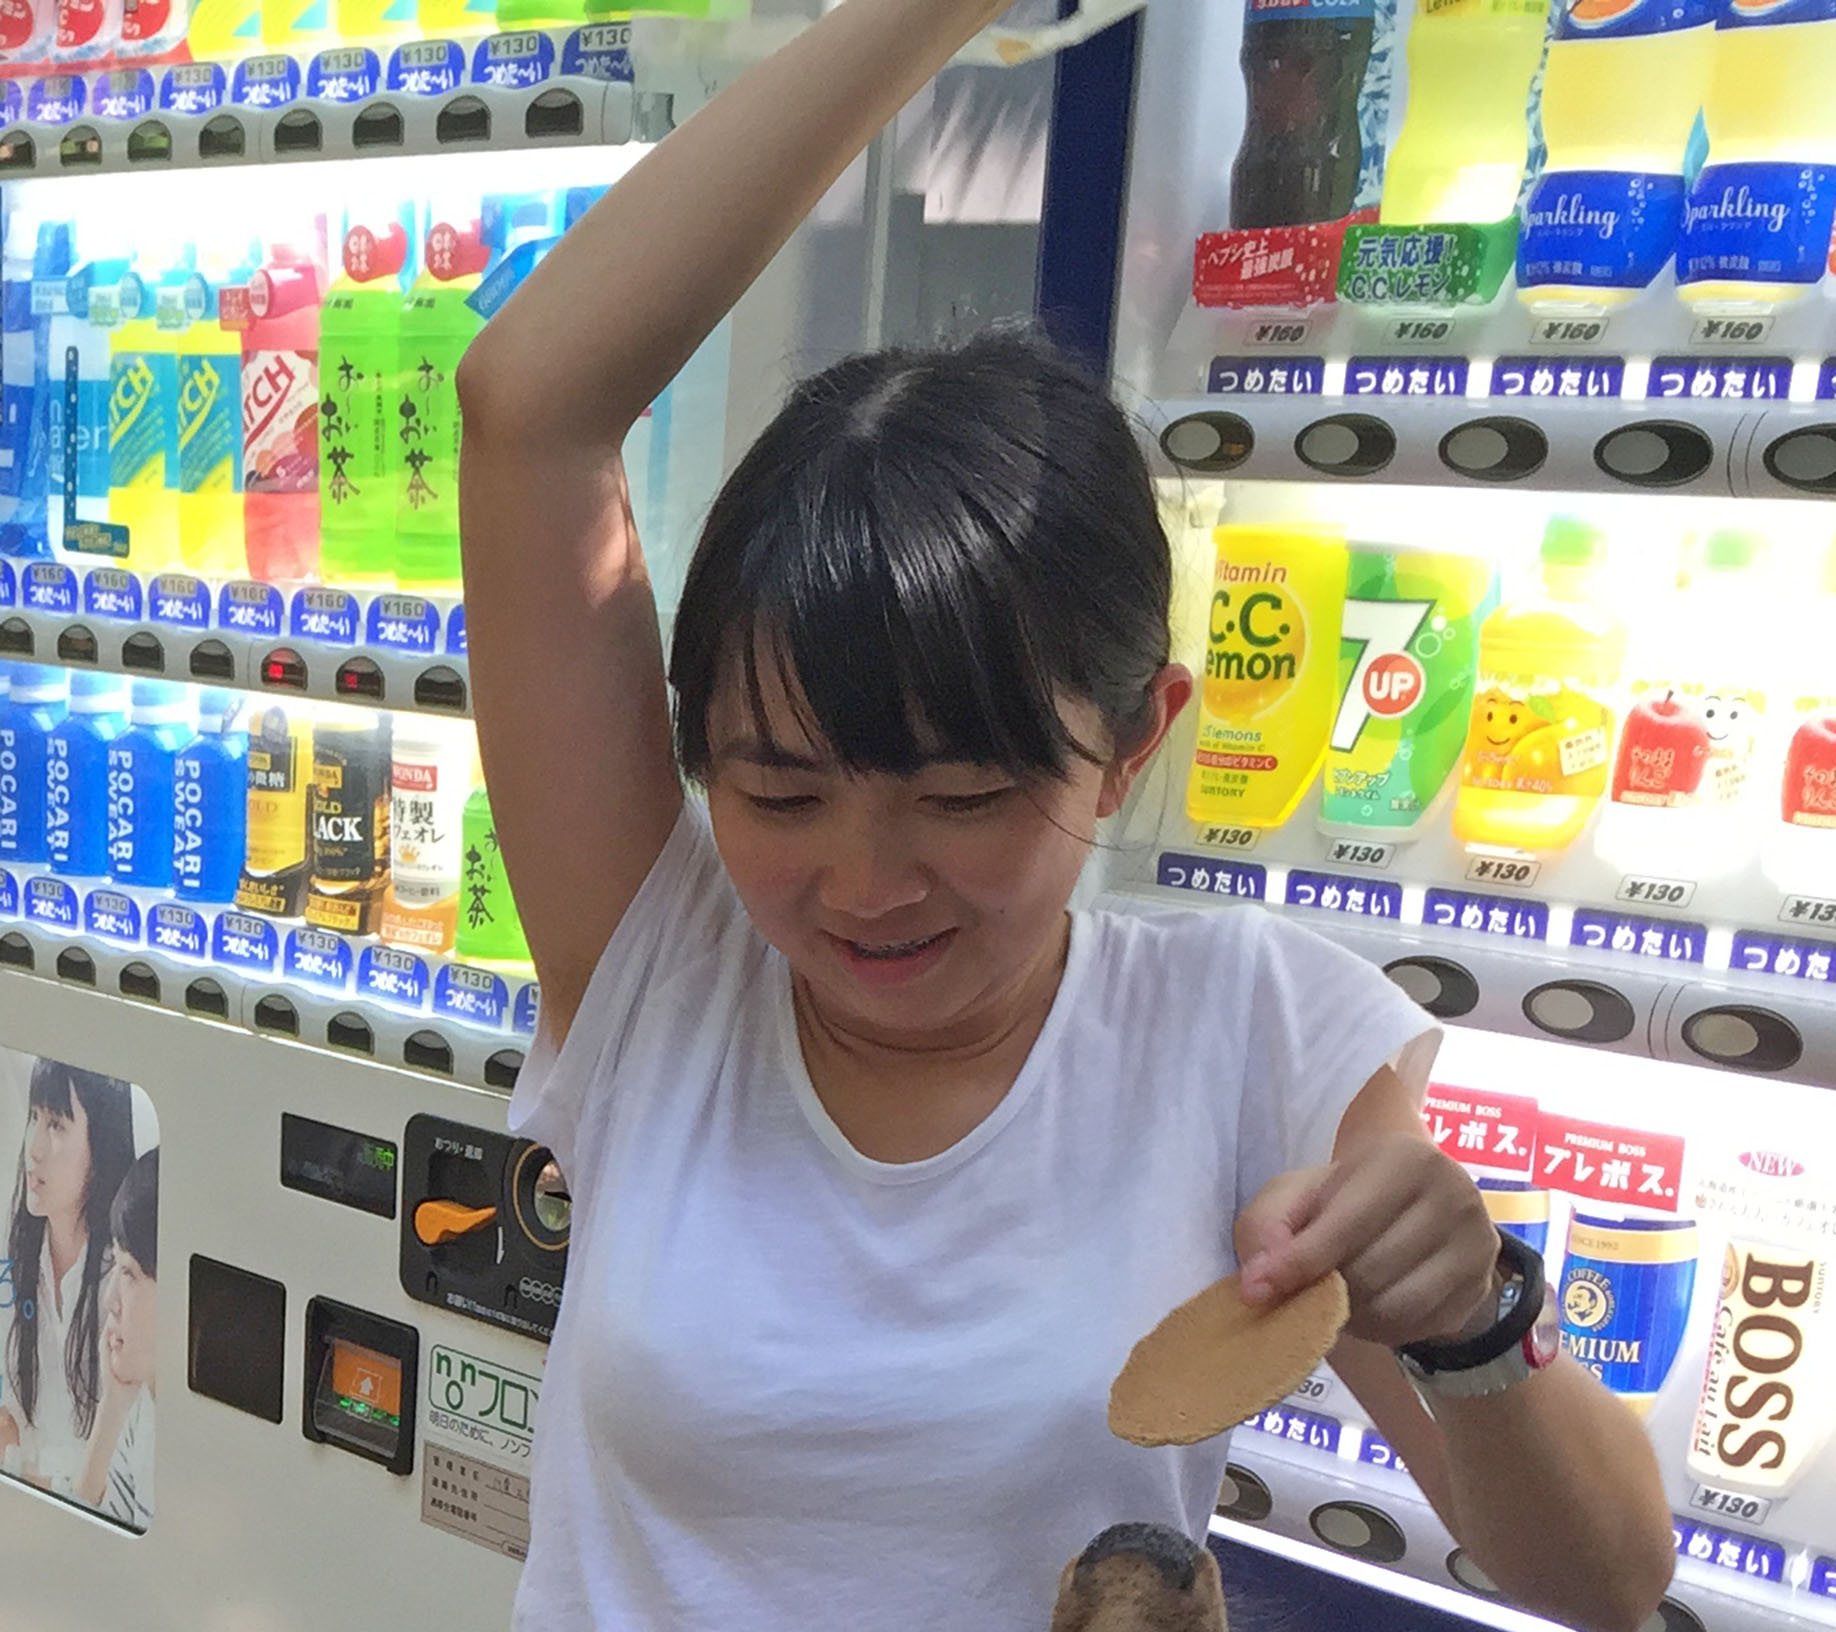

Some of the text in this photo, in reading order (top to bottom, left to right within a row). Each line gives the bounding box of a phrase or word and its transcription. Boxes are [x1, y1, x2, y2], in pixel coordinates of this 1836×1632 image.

[403, 45, 447, 65] ¥130
[491, 34, 537, 54] ¥130
[322, 50, 364, 71] ¥130
[1520, 193, 1621, 240] Sparkling
[1684, 185, 1791, 235] Sparkling
[1255, 324, 1305, 343] ¥160
[1395, 322, 1449, 340] ¥160
[1542, 322, 1602, 341] ¥160
[1702, 319, 1764, 339] ¥160
[1218, 368, 1313, 394] つめたい
[1355, 368, 1456, 395] つめたい
[1501, 368, 1610, 397] つめたい
[1660, 369, 1777, 398] つめたい
[321, 392, 361, 505] お茶
[400, 393, 439, 511] お茶
[231, 583, 269, 602] ¥160
[305, 591, 346, 610] ¥160
[382, 599, 424, 617] ¥160
[1206, 648, 1297, 682] emon
[1329, 597, 1438, 754] 7
[1368, 670, 1415, 701] UP
[1, 729, 17, 850] POCARI
[53, 738, 70, 862] POCARI
[108, 748, 119, 862] SWEAT
[117, 750, 134, 873] POCARI
[173, 758, 186, 876] SWEAT
[184, 759, 202, 888] POCARI
[1203, 827, 1254, 847] ¥130
[1333, 842, 1385, 864] ¥130
[1167, 865, 1256, 896] つめたい
[1475, 859, 1531, 882] ¥130
[466, 844, 496, 930] お茶
[1295, 883, 1391, 917] つめたい
[1625, 879, 1685, 903] ¥130
[159, 906, 194, 925] ¥130
[1433, 902, 1536, 938] つめたい
[1788, 899, 1836, 922] ¥13
[226, 916, 264, 935] ¥130
[299, 931, 338, 951] ¥130
[1583, 923, 1693, 961] つめたい
[373, 950, 414, 972] ¥130
[450, 968, 493, 990] ¥130
[1424, 1096, 1502, 1119] PREMIUM BOSS
[1564, 1132, 1647, 1158] PREMIUM BOSS
[1750, 1150, 1794, 1177] NEW
[1558, 1329, 1642, 1364] EMIUM
[1717, 1252, 1815, 1471] BOSS
[1297, 1379, 1325, 1398] 30
